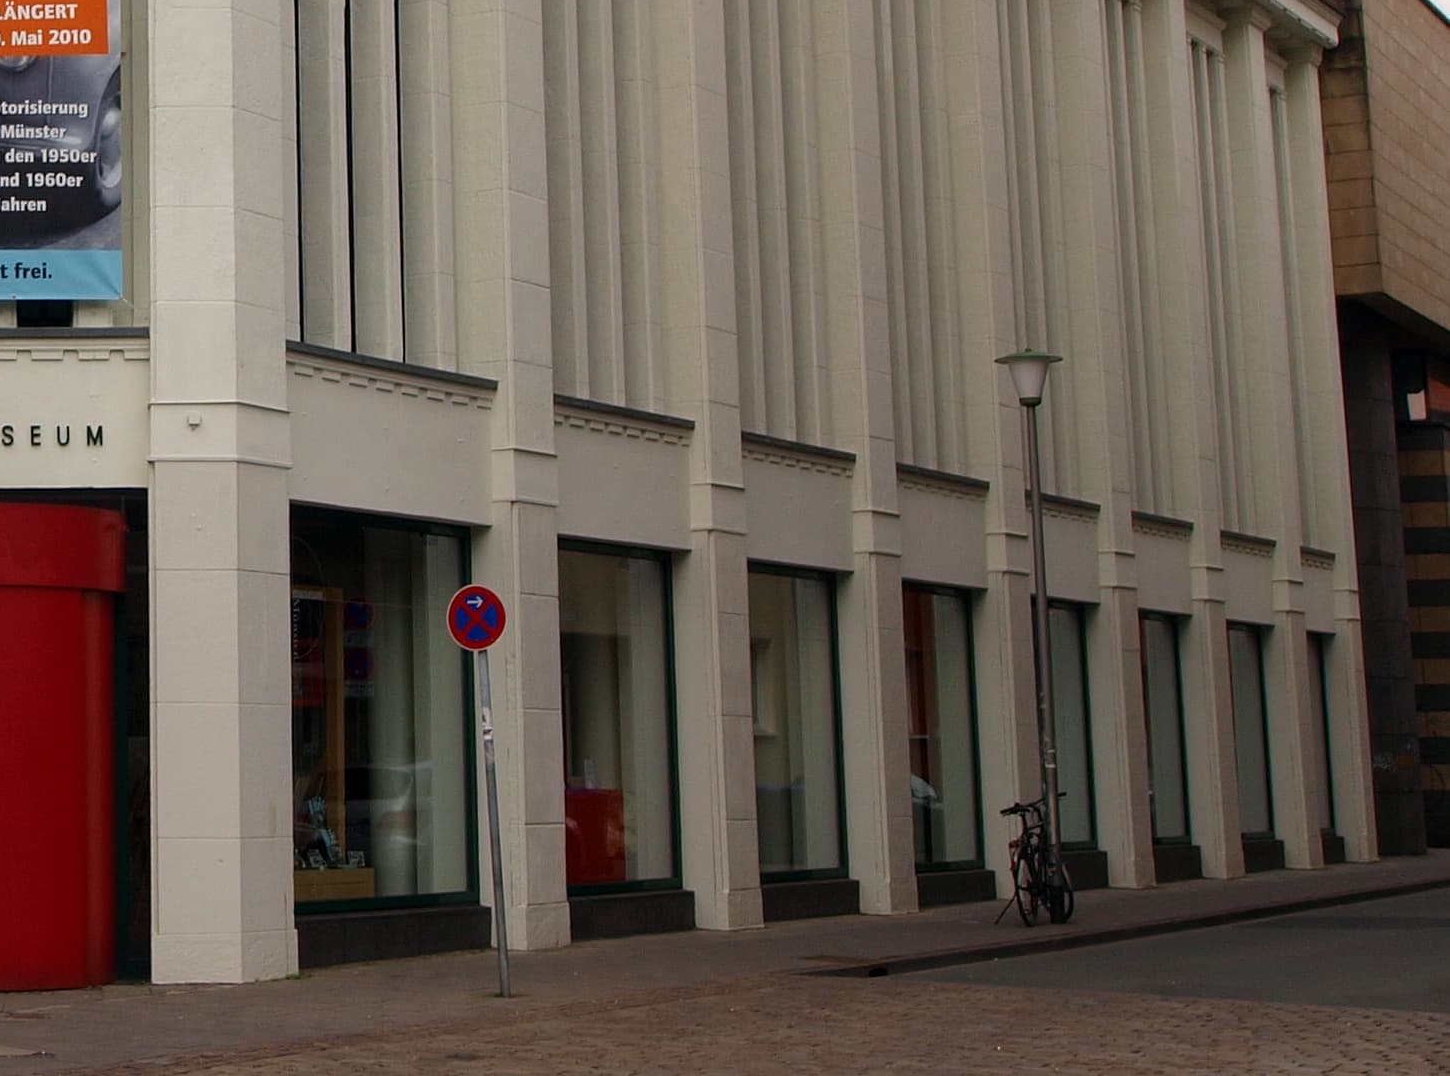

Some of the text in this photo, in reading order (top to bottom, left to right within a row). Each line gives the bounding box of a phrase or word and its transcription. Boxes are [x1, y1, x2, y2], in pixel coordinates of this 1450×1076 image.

[11, 30, 43, 46] Mai
[49, 29, 92, 45] 2010
[0, 123, 66, 139] Münster
[4, 149, 34, 163] den
[40, 149, 97, 164] 1950er
[26, 173, 83, 188] 1960er
[13, 262, 53, 280] frei.
